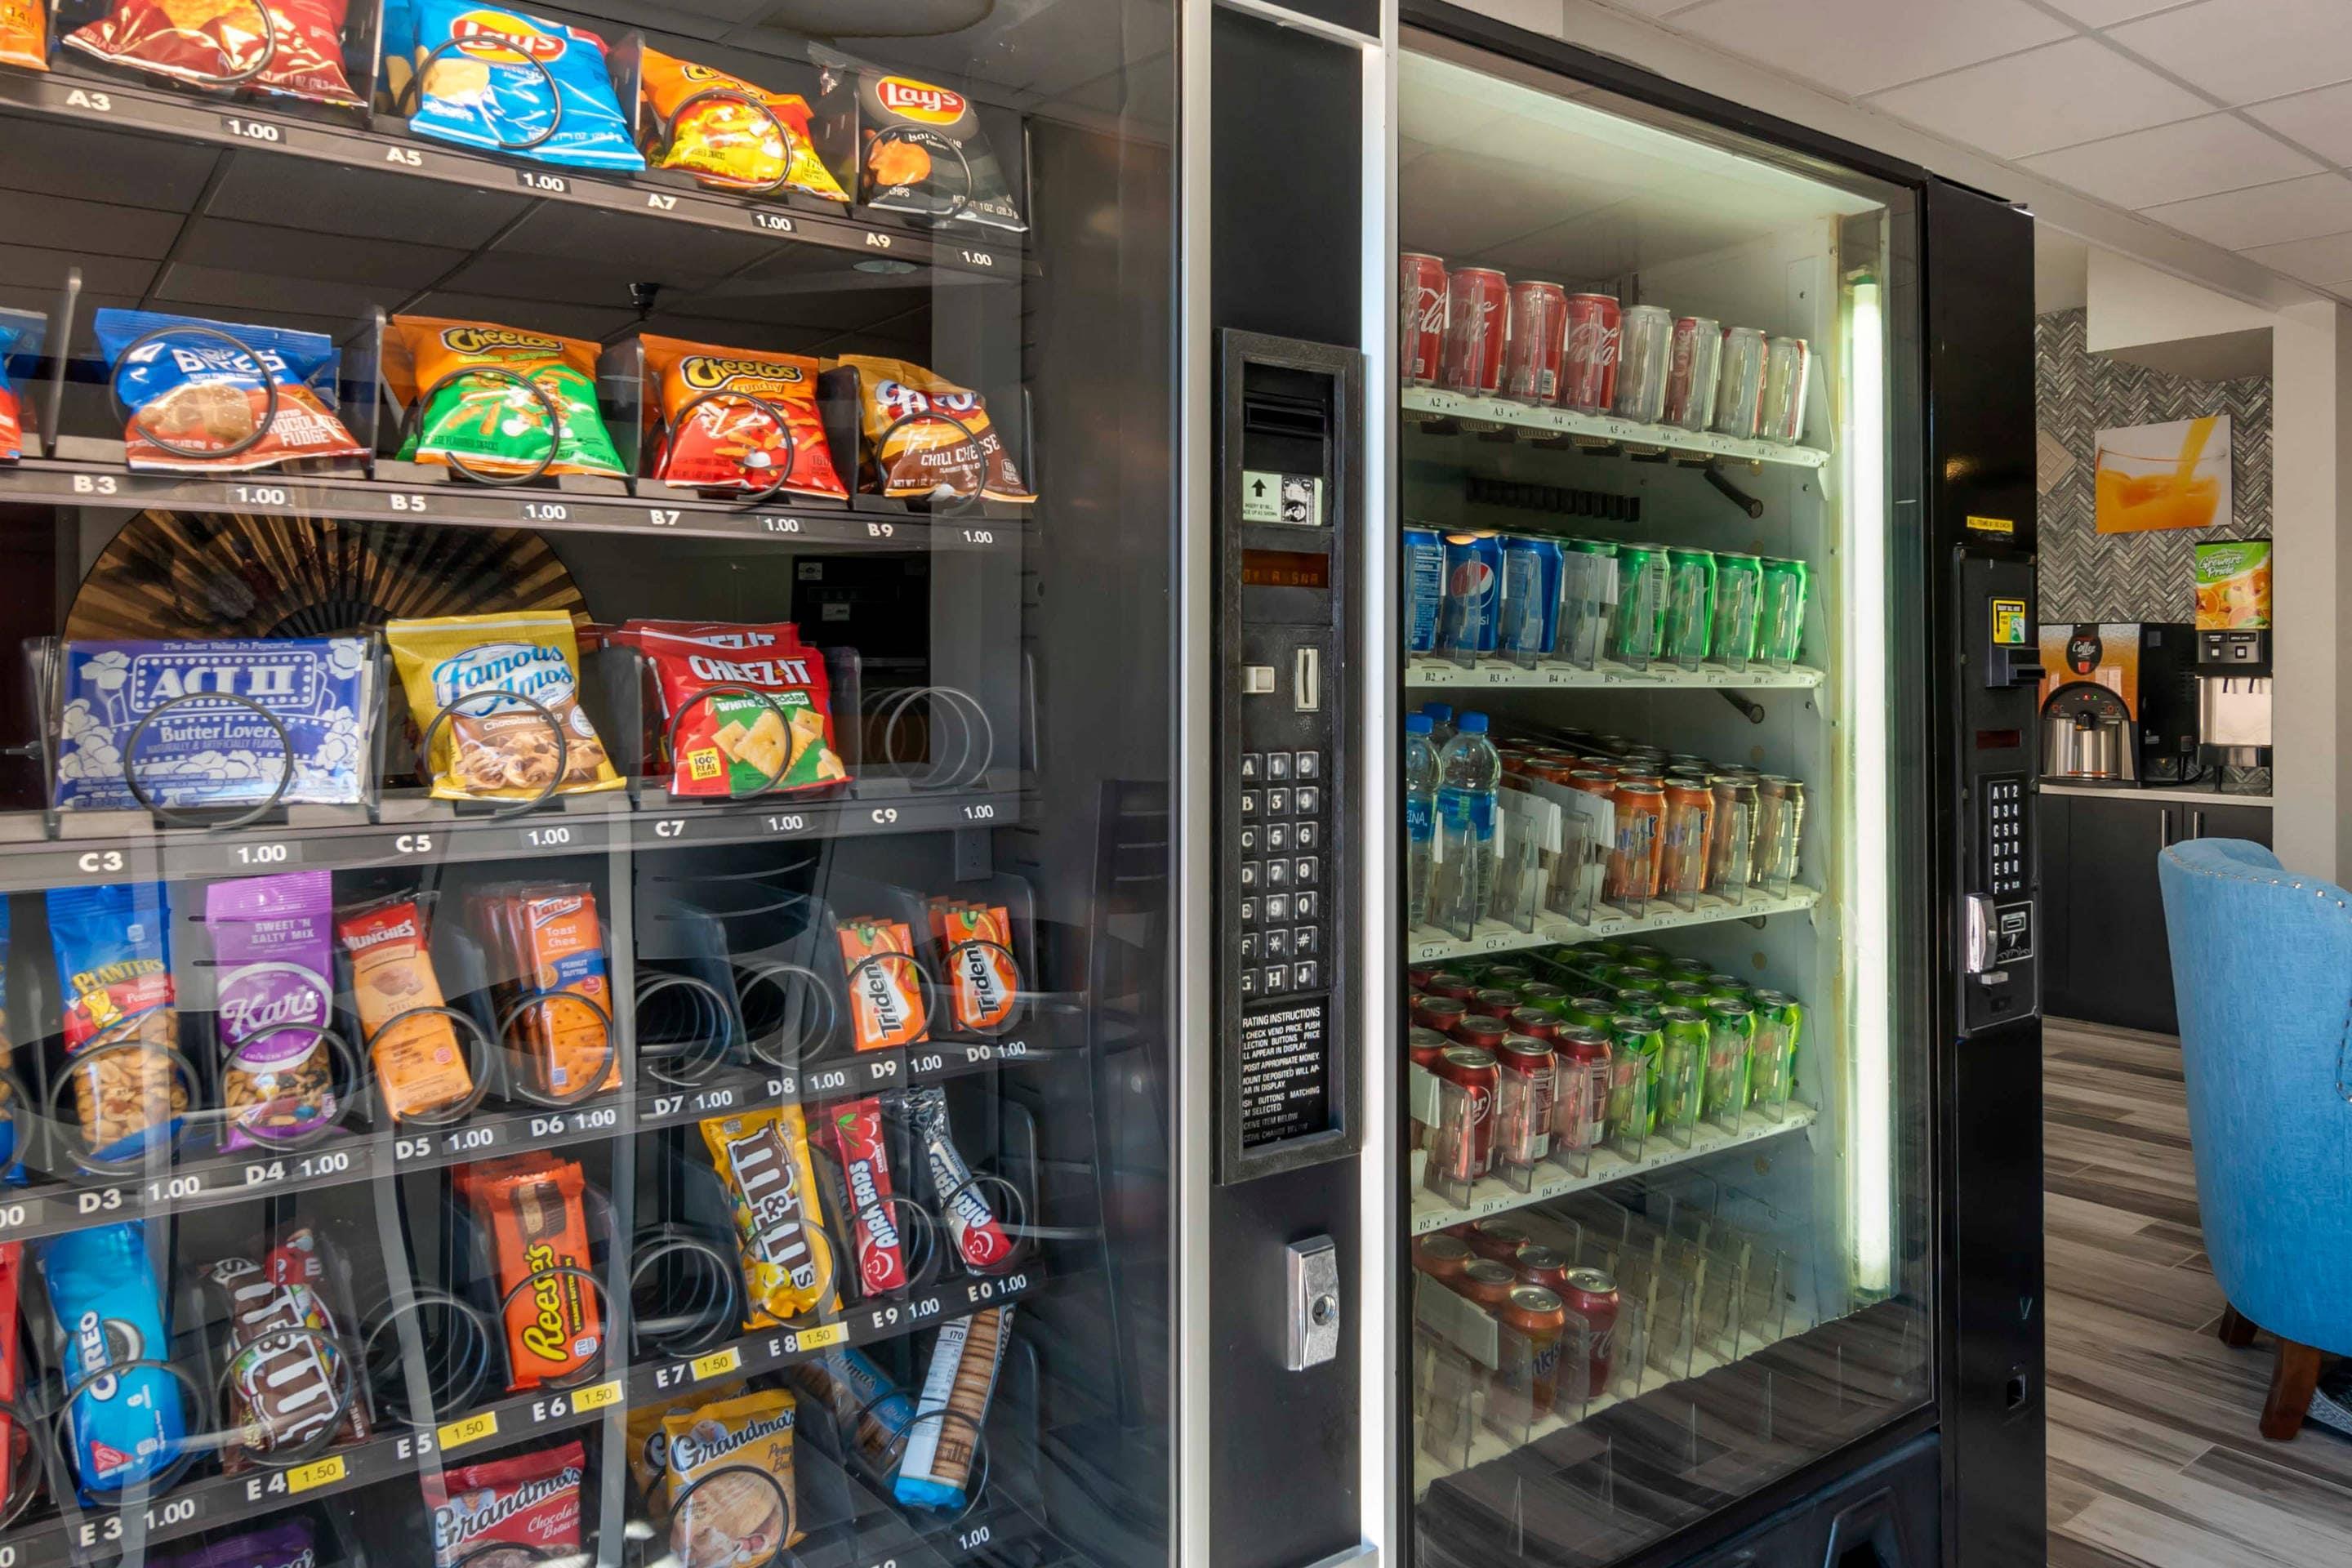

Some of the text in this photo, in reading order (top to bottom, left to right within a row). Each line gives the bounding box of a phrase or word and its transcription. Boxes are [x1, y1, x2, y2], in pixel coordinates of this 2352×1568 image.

[67, 90, 112, 111] A3
[887, 83, 958, 112] Lay's
[229, 119, 279, 142] 1.00
[386, 148, 422, 166] A5
[523, 173, 564, 192] 1.00
[648, 194, 676, 210] A7
[755, 213, 792, 232] 1.00
[866, 232, 892, 247] A9
[962, 250, 992, 266] 1.00
[448, 327, 559, 352] Cheetos
[685, 357, 796, 389] Cheetos
[726, 381, 784, 393] Crunchy
[1429, 398, 1441, 408] A2
[1493, 407, 1504, 416] A3
[1552, 416, 1562, 425] A4
[1609, 425, 1619, 434] A5
[280, 429, 332, 447] FUDGE
[921, 434, 1000, 466] CHILI CHESE
[236, 488, 285, 506] 1.00
[526, 504, 566, 519] 1.00
[650, 510, 680, 526] B7
[764, 518, 800, 532] 1.00
[868, 523, 893, 537] B9
[963, 530, 993, 545] 1.00
[432, 645, 565, 700] Famous
[1425, 672, 1436, 681] B2
[1490, 674, 1500, 682] B3
[1548, 674, 1559, 683] B4
[150, 665, 297, 699] ACT II
[475, 665, 574, 716] Amos
[483, 716, 538, 731] Chocolate
[160, 723, 281, 743] Butter Lovers
[1242, 759, 1311, 775] A 1 2
[1242, 793, 1311, 811] B 3 4
[871, 808, 898, 824] C9
[964, 804, 994, 820] 1.00
[656, 821, 685, 837] C7
[768, 815, 804, 831] 1.00
[528, 828, 570, 846] 1.00
[1241, 828, 1310, 847] C 5 6
[237, 844, 287, 864] 1.00
[1242, 863, 1310, 883] D 7 8
[1242, 904, 1252, 919] E
[1271, 902, 1280, 916] 9
[255, 919, 295, 933] SWEET
[343, 919, 416, 951] MUNCHIES
[545, 924, 577, 937] Toast
[252, 929, 314, 944] SALTY MIX
[1486, 939, 1497, 949] C3
[1242, 939, 1251, 955] F
[1422, 948, 1433, 958] C2
[72, 957, 166, 995] PLANTERS
[562, 968, 589, 978] BUTTER
[1268, 969, 1307, 987] H J
[1242, 1006, 1321, 1028] RATING INSTRUCTIONS
[1245, 1021, 1321, 1040] CHECK VEND PUSH
[1303, 1030, 1321, 1040] PRICE
[997, 1040, 1027, 1058] 1.00
[1252, 1048, 1275, 1059] APPEAR
[1275, 1047, 1282, 1055] IN
[911, 1054, 942, 1073] 1.00
[1261, 1056, 1298, 1070] APPROPRIATE
[1298, 1052, 1321, 1063] MONEY.
[871, 1061, 898, 1080] D9
[1263, 1067, 1309, 1080] DEPOSITED WILL
[768, 1078, 796, 1096] D8
[810, 1071, 845, 1090] 1.00
[1253, 1085, 1260, 1093] IN
[695, 1091, 733, 1110] 1.00
[1258, 1085, 1321, 1105] BUTTONS MATCHING
[655, 1096, 684, 1116] D7
[531, 1115, 565, 1137] D6
[575, 1108, 617, 1129] 1.00
[395, 1138, 432, 1160] D5
[449, 1129, 494, 1152] 1.00
[246, 1161, 286, 1186] D4
[300, 1153, 349, 1178] 1.00
[1598, 1172, 1609, 1181] D5
[149, 1176, 201, 1201] 1.00
[1542, 1188, 1552, 1197] D4
[78, 1188, 122, 1214] D3
[1419, 1221, 1431, 1230] D2
[997, 1275, 1027, 1294] 1.00
[523, 1244, 569, 1362] Reese's
[907, 1298, 940, 1318] 1.00
[805, 1328, 831, 1344] 1.50
[949, 1330, 964, 1341] 170
[79, 1311, 118, 1401] OREO
[701, 1356, 729, 1373] 1.50
[583, 1387, 612, 1405] 1.50
[452, 1420, 484, 1440] 1.50
[301, 1463, 337, 1483] 1.50
[143, 1499, 195, 1530] 1.00
[435, 1466, 583, 1549] Grandma's
[959, 1526, 991, 1550] 1.00
